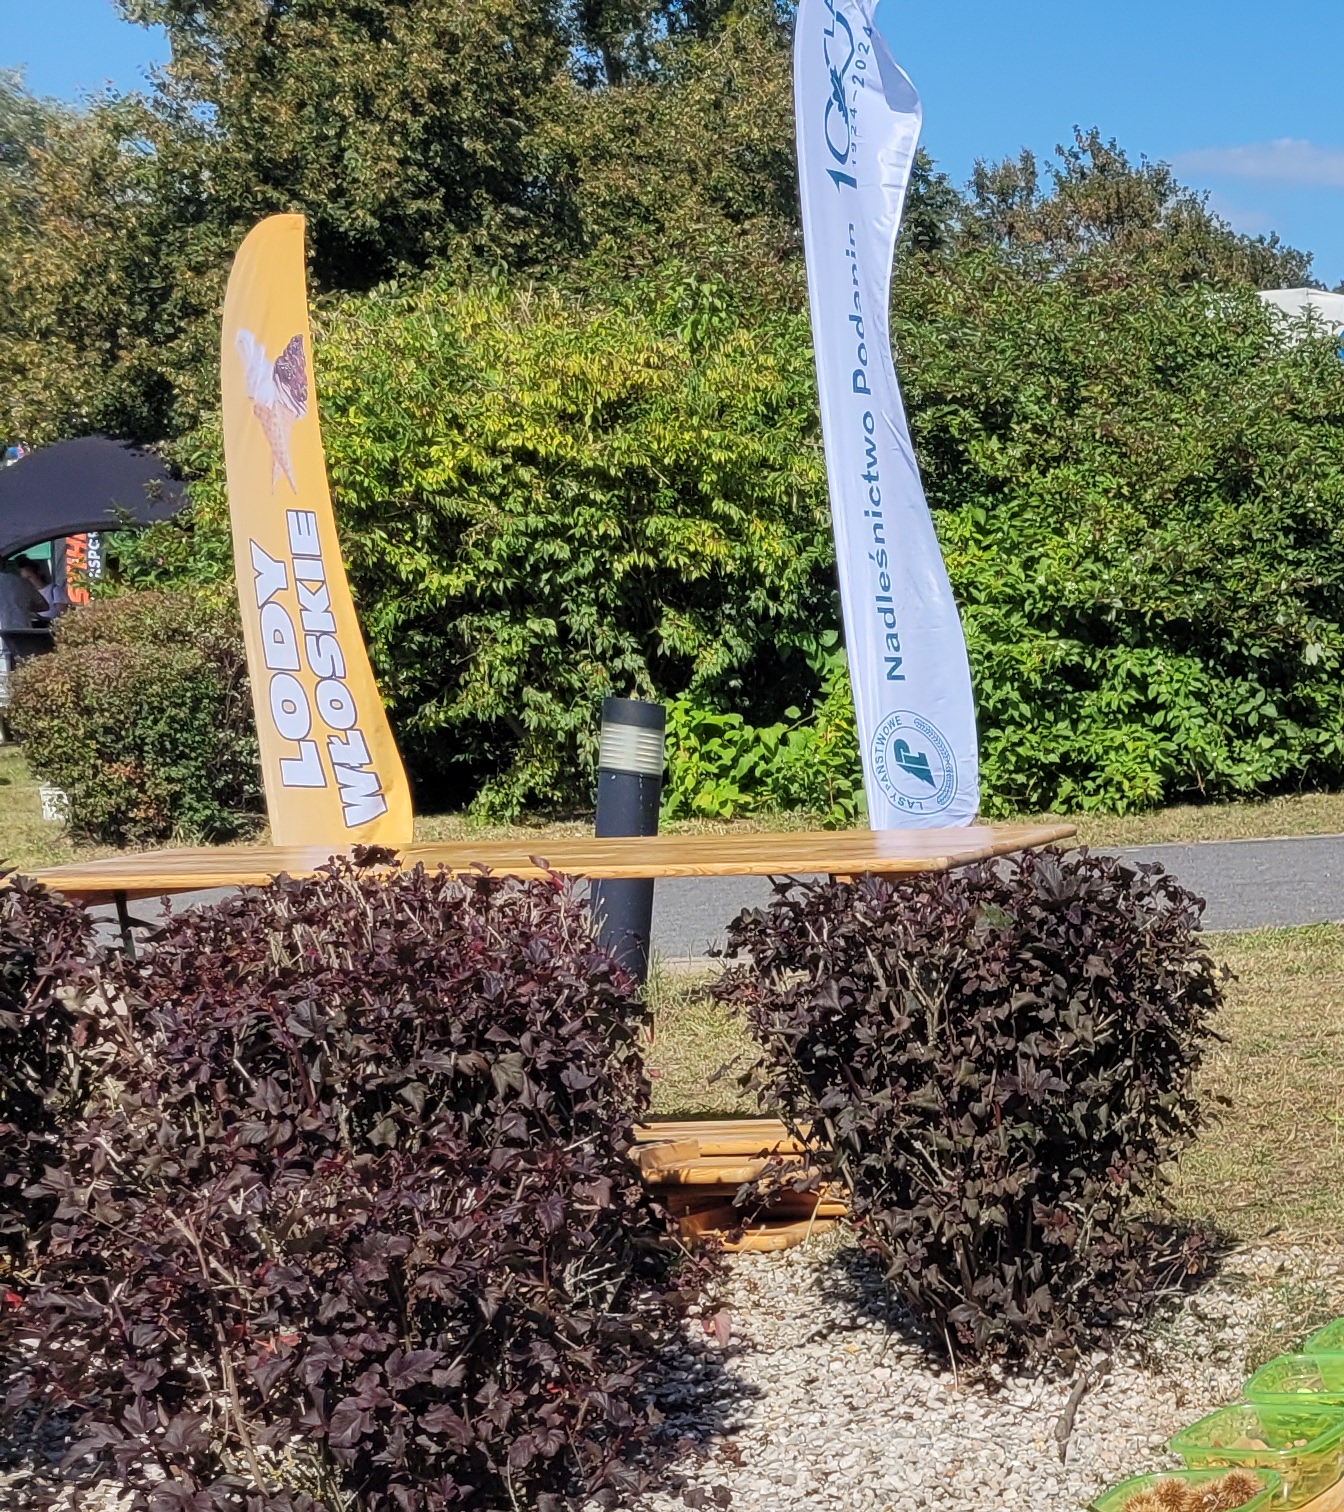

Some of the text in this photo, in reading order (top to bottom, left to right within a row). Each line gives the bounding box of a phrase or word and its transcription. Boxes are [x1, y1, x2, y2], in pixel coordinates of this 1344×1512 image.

[843, 222, 906, 681] Nadleśnictwo Podanin
[249, 538, 327, 788] LODY
[286, 509, 388, 828] WŁOSKIE
[890, 792, 924, 811] LASY
